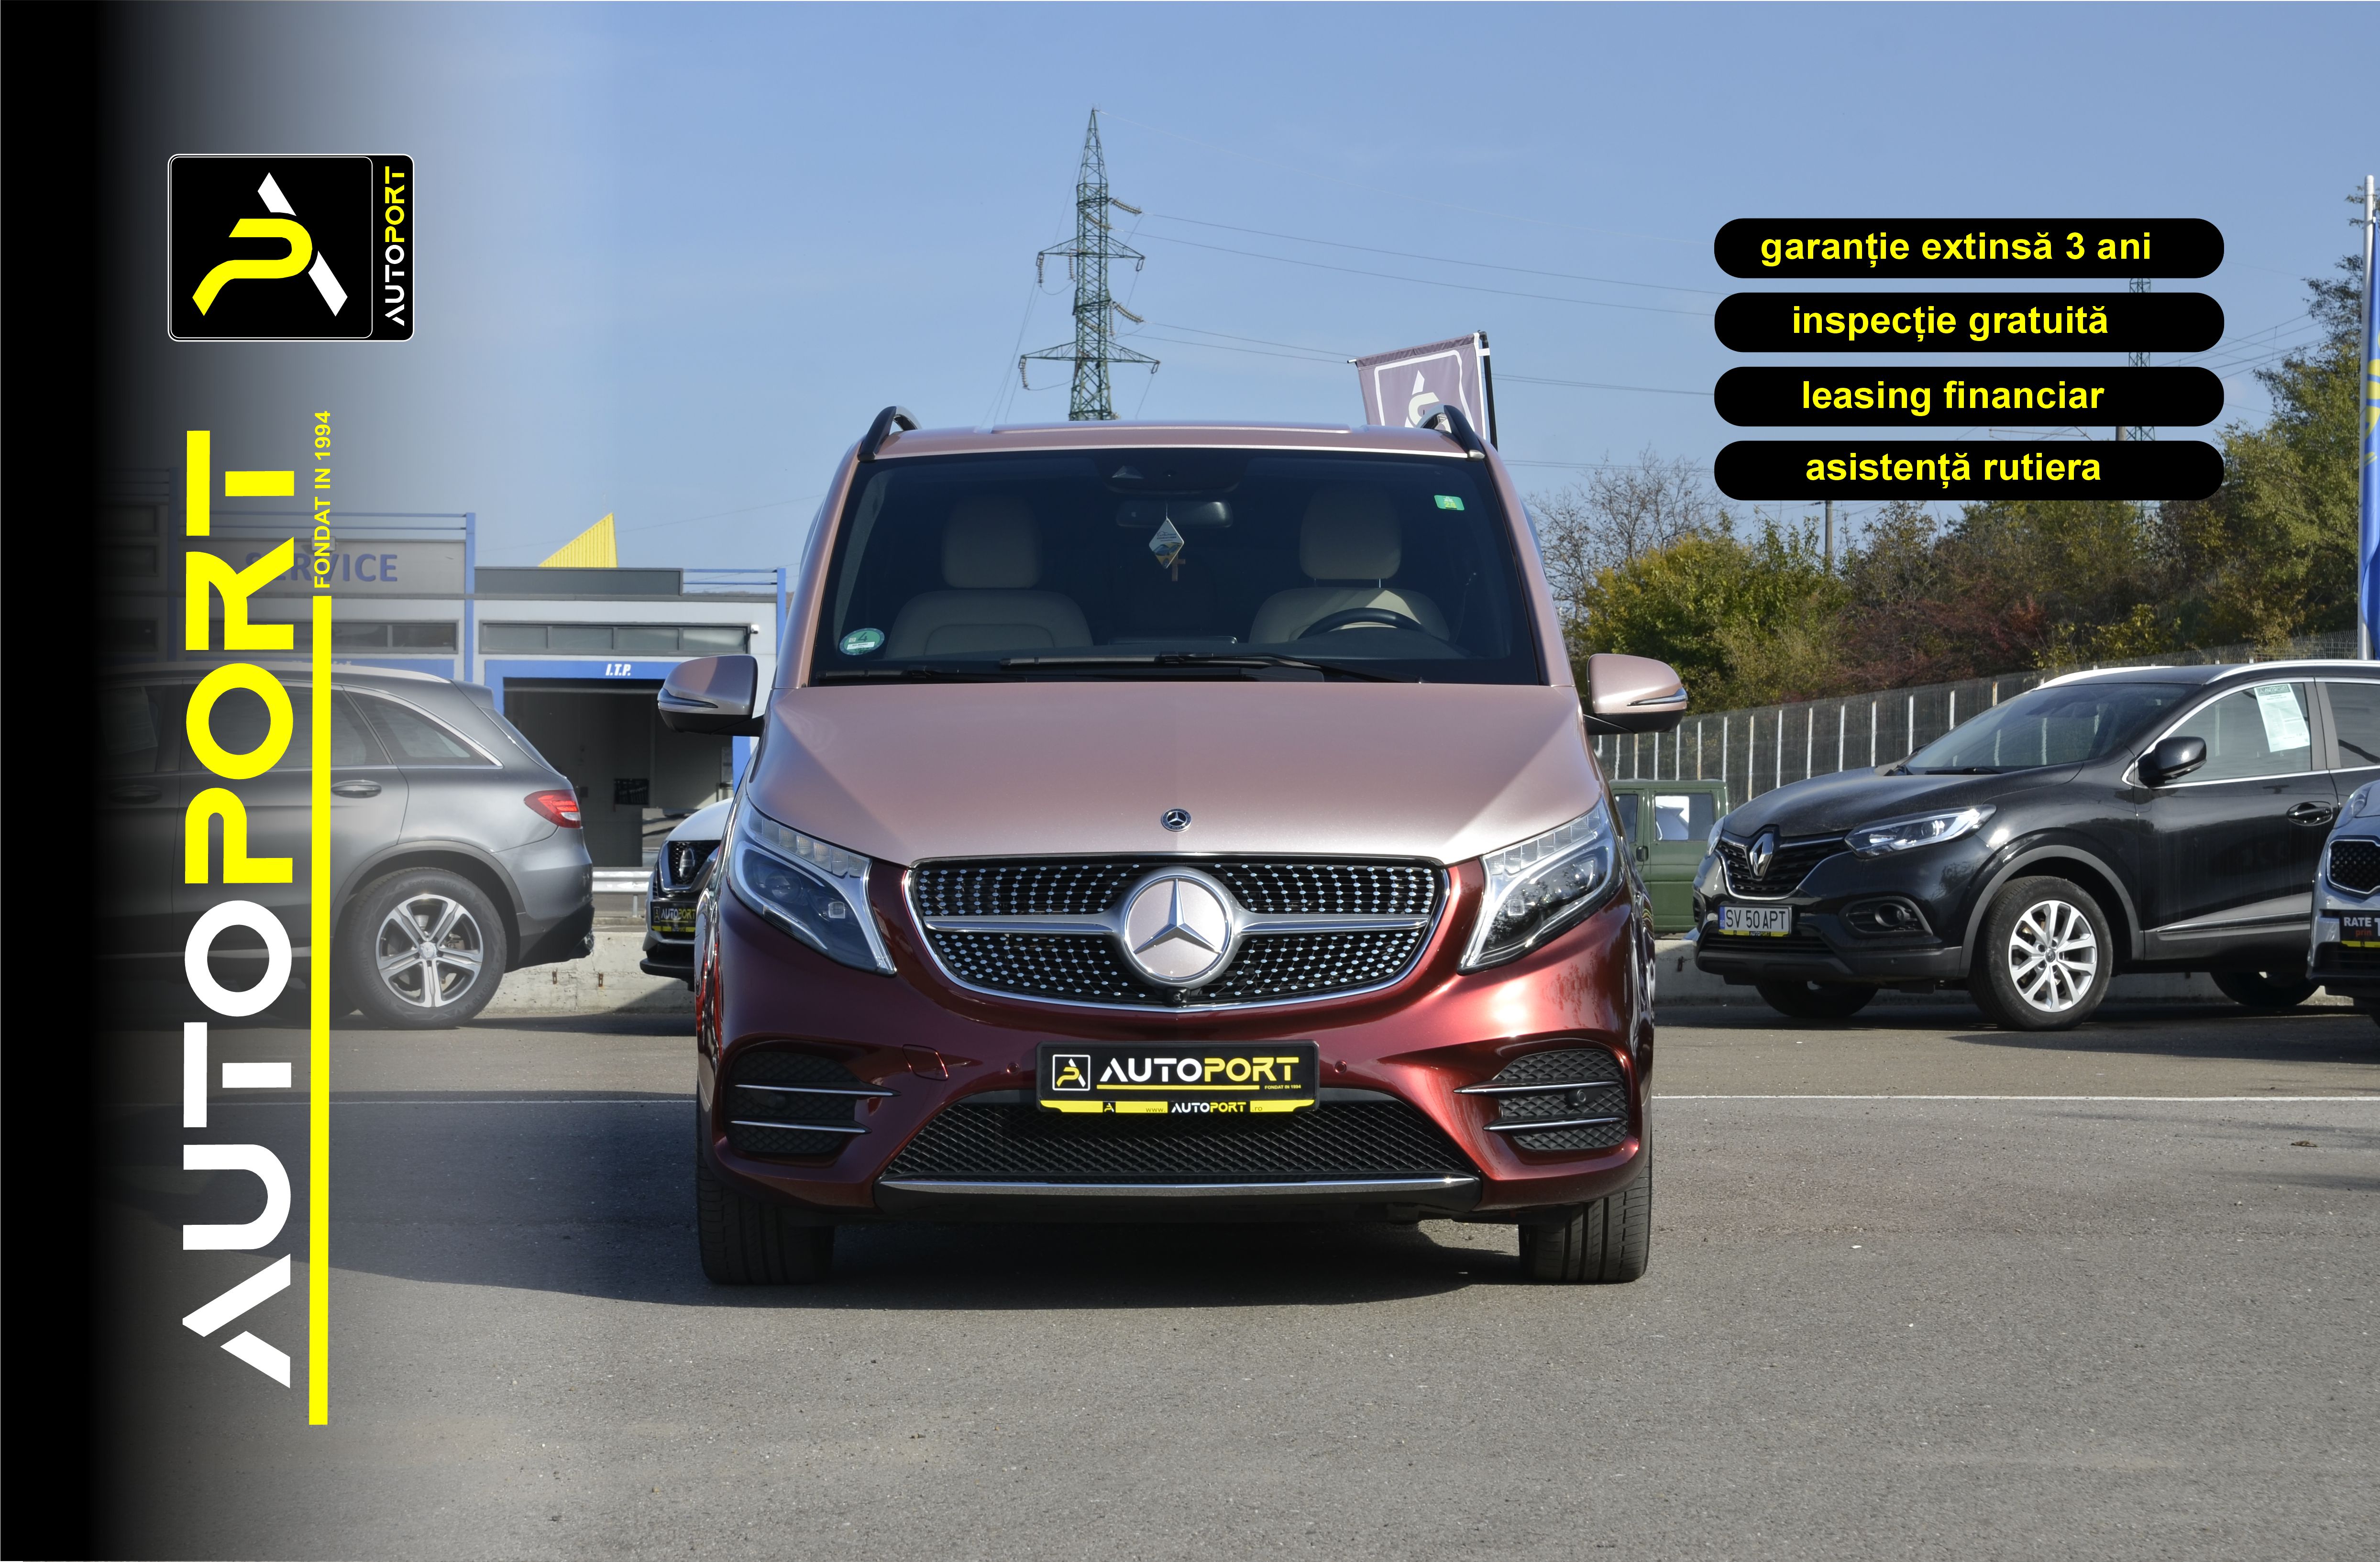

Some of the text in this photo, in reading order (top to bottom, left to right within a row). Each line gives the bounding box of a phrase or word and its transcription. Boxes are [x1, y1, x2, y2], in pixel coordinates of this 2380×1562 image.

[245, 552, 397, 582] RVICE
[858, 632, 868, 641] 4
[606, 664, 631, 676] I.T.P.
[661, 908, 696, 919] AUTOPORT
[1726, 910, 1785, 929] SV 50 APT
[2344, 917, 2372, 927] RATE
[1100, 1057, 1299, 1082] AUTOPORT
[1171, 1102, 1246, 1113] AUTOPORT
